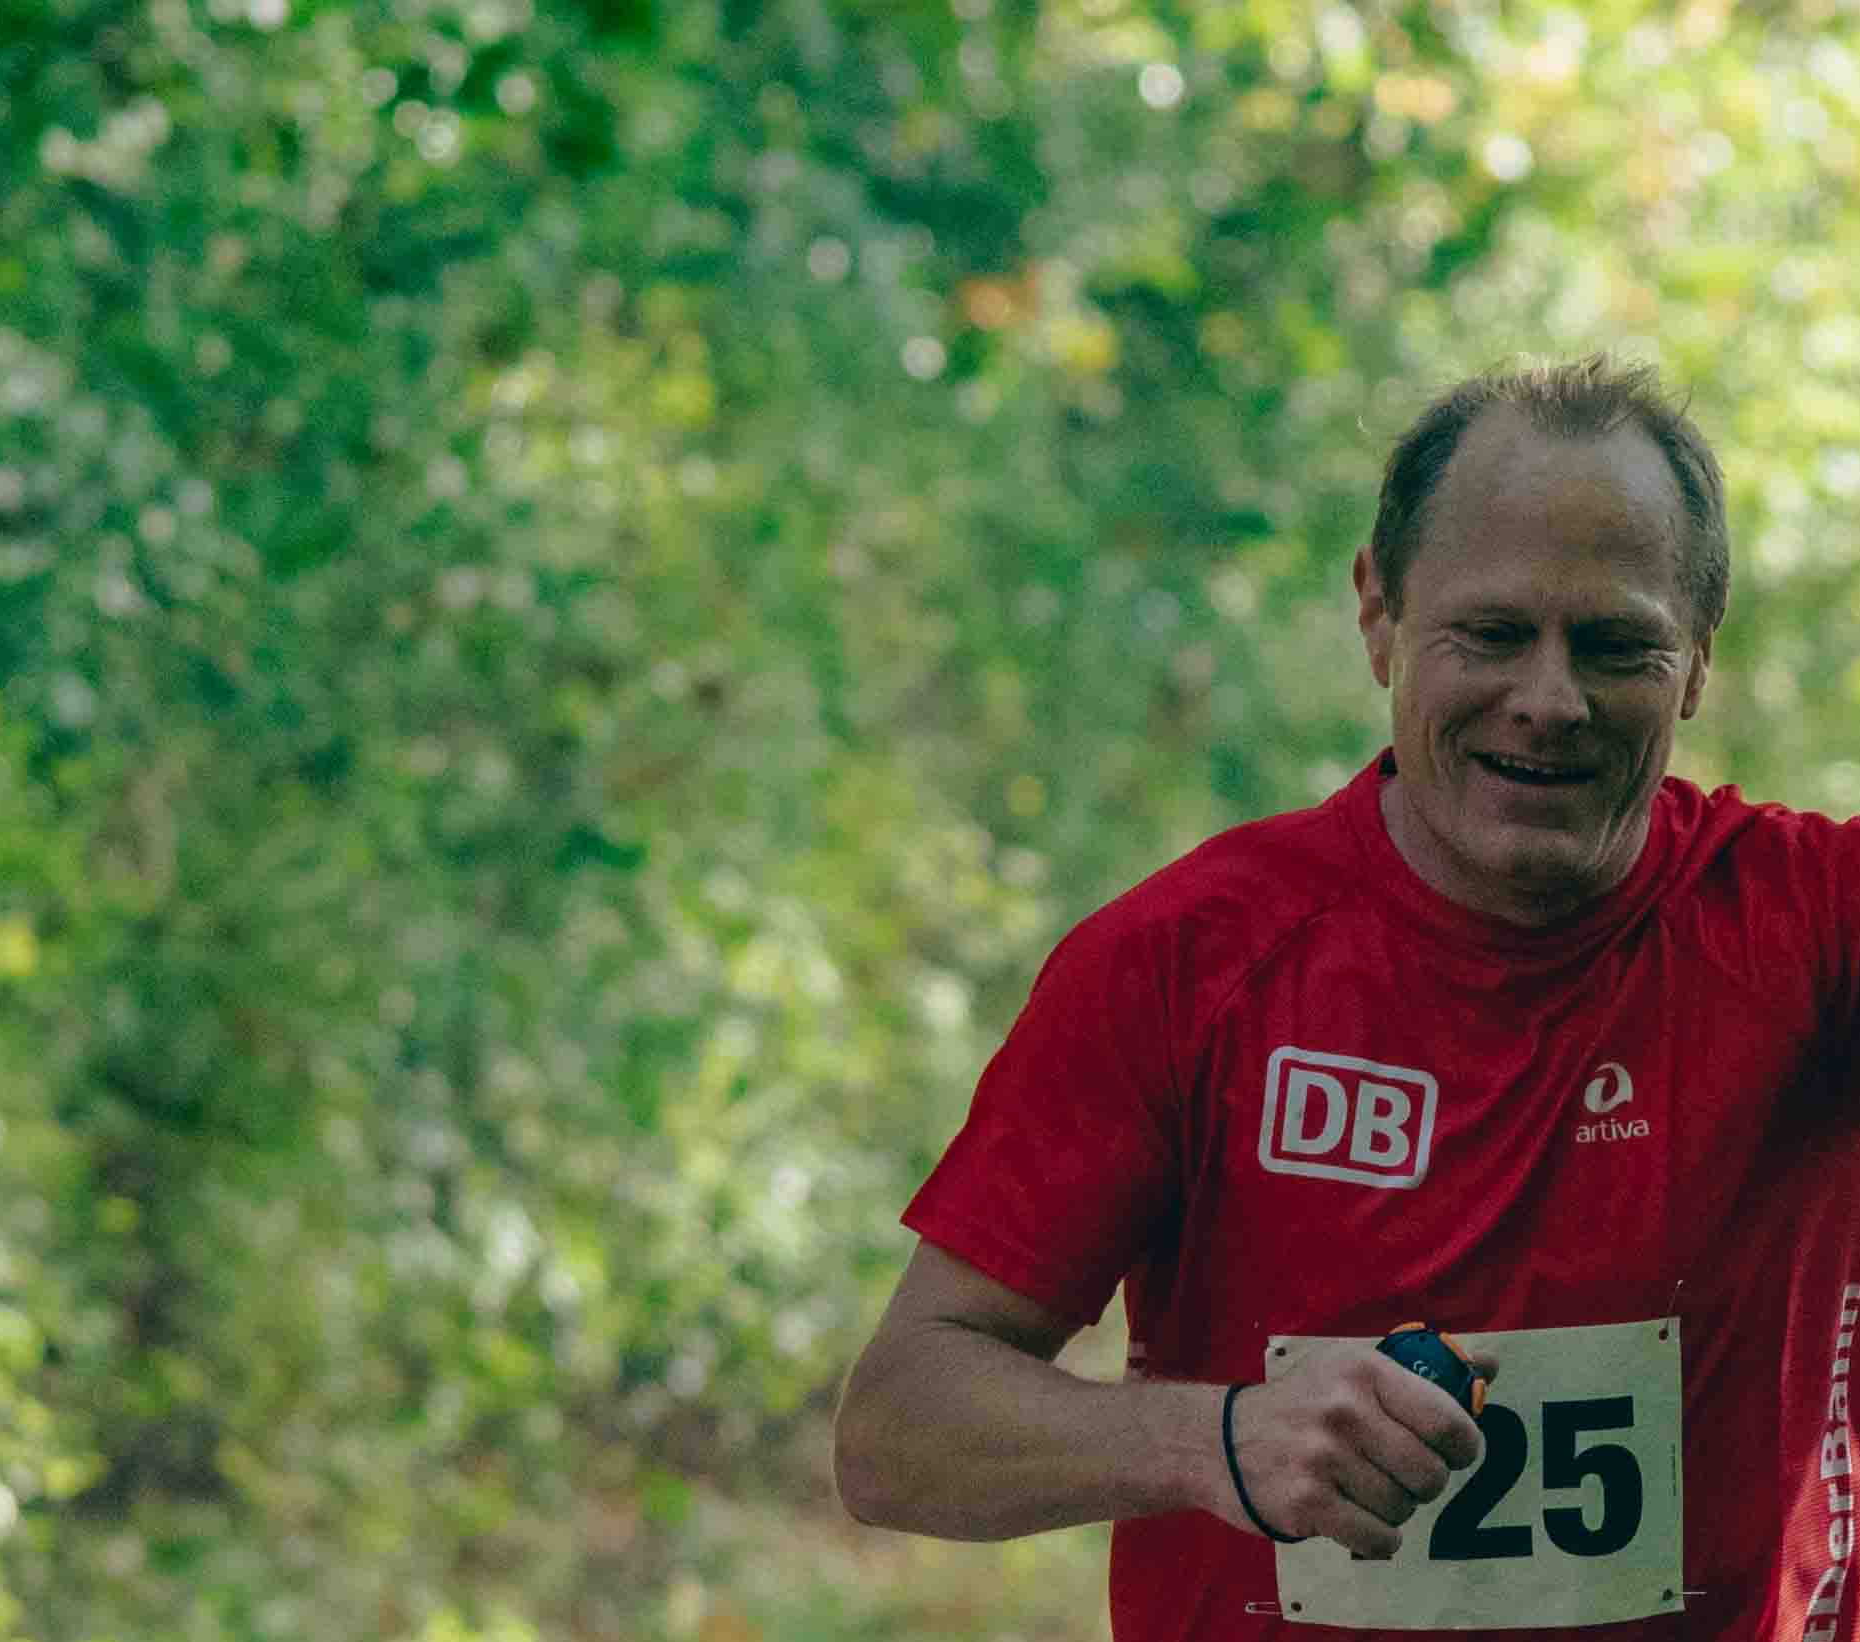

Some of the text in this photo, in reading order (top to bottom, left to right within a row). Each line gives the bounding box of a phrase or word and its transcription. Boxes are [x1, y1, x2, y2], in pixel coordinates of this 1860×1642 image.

[1281, 1067, 1411, 1167] DB
[1576, 1116, 1651, 1144] artiva
[1351, 1396, 1643, 1561] 25
